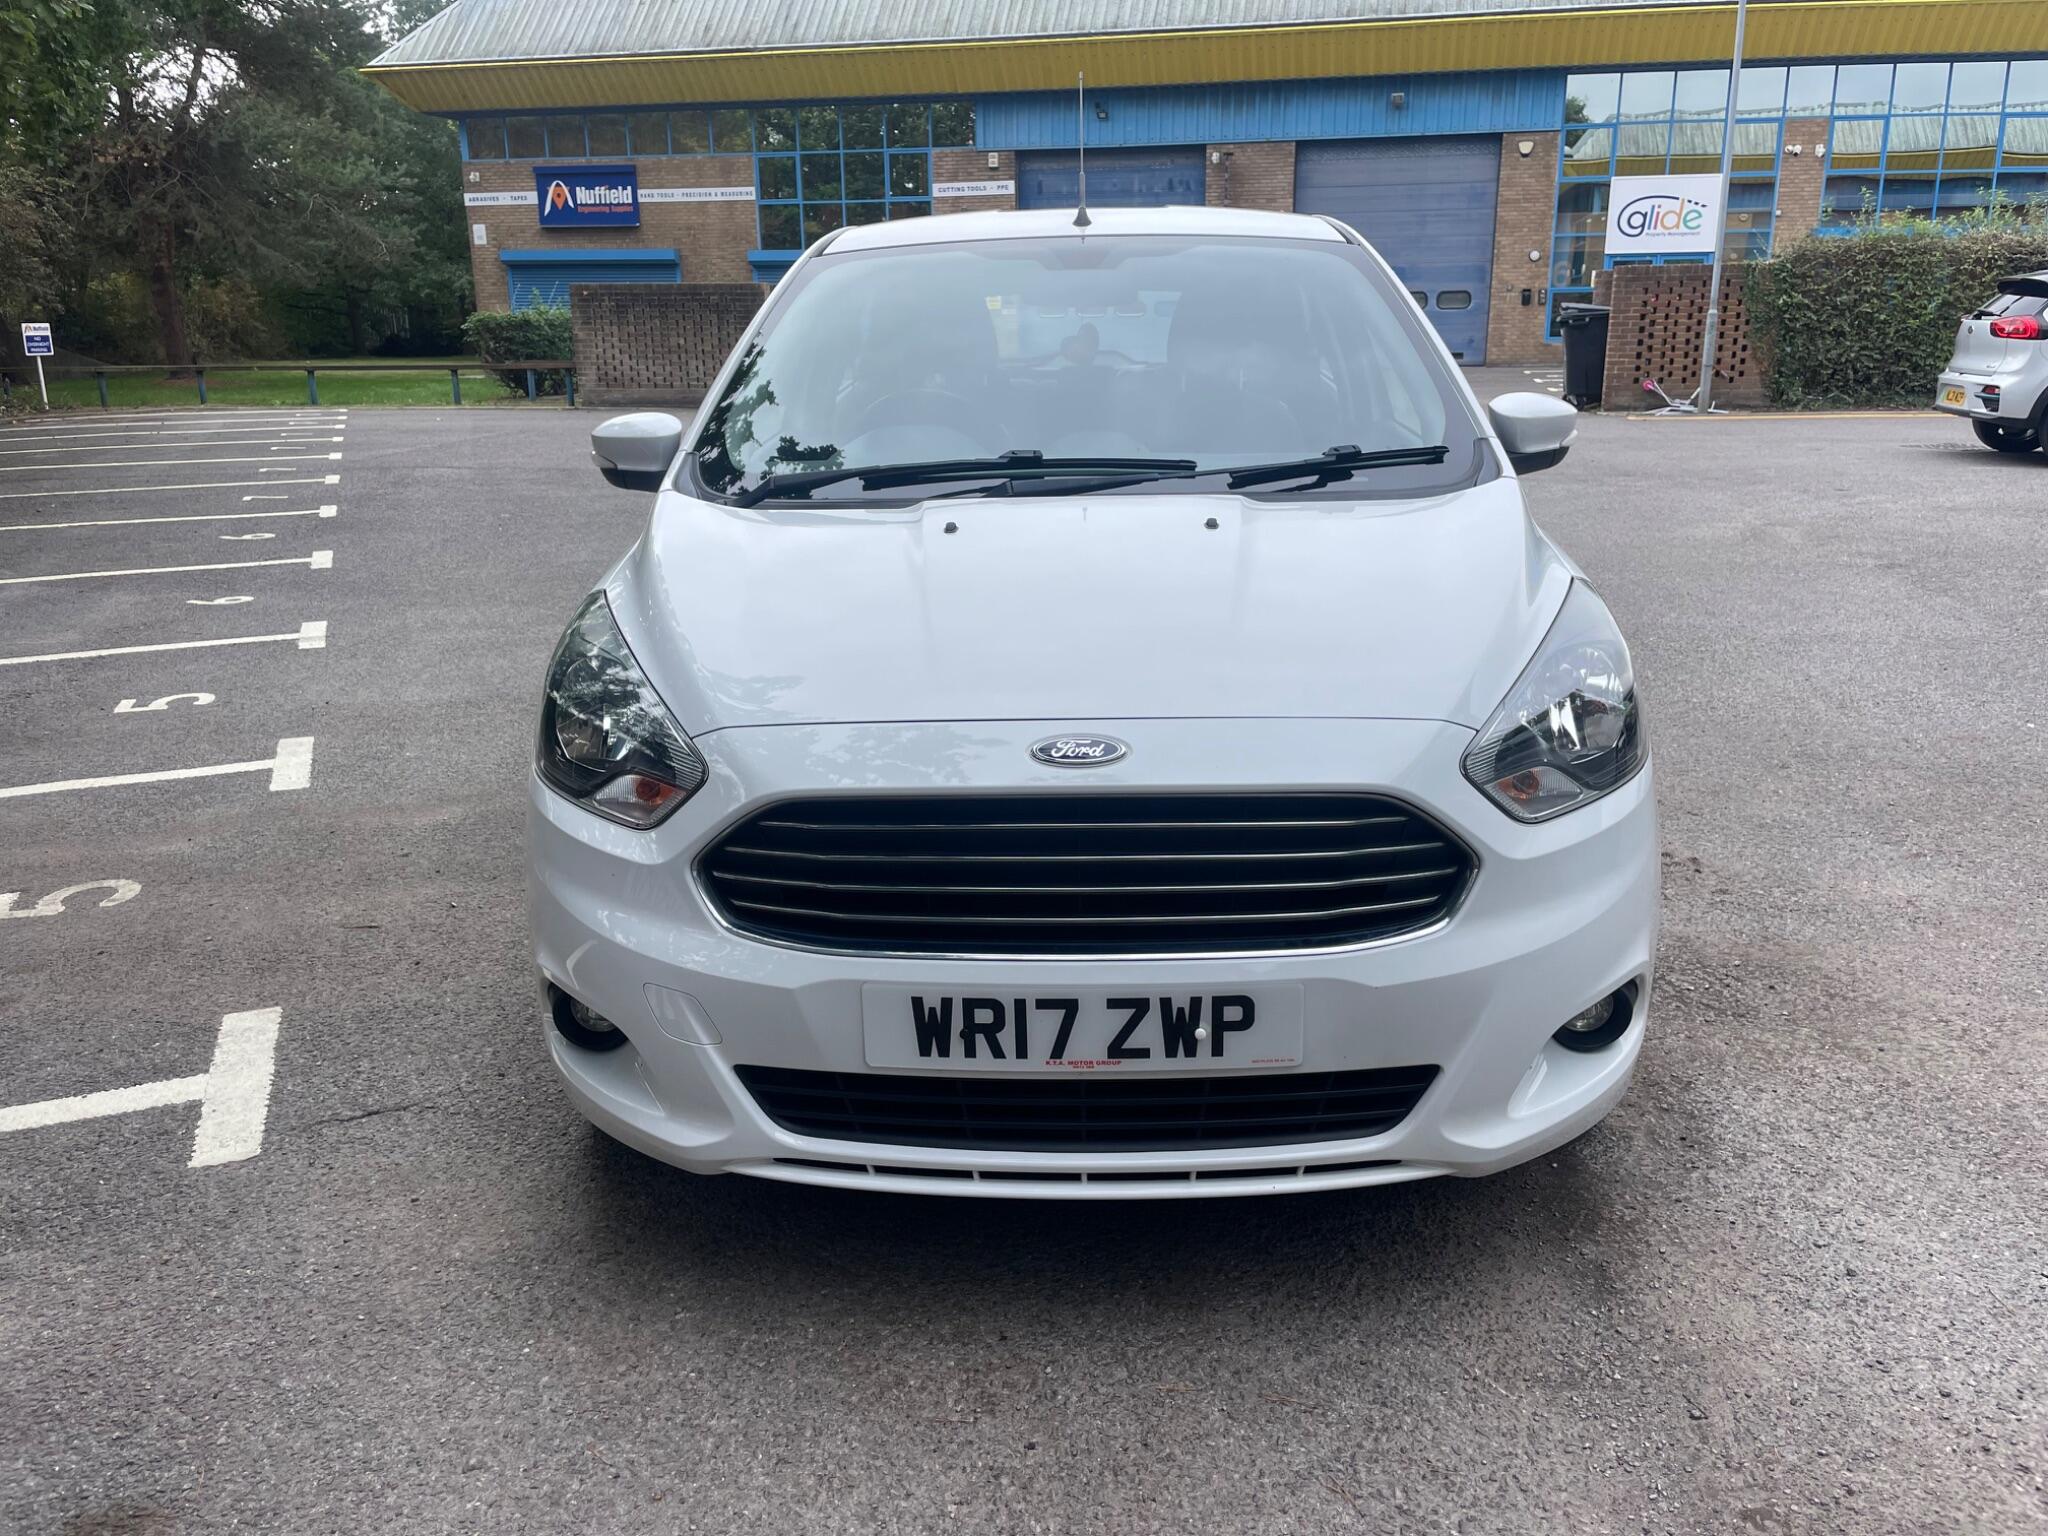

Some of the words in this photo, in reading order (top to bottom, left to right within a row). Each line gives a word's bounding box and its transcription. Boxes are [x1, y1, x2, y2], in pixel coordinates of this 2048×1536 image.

[576, 185, 632, 204] Nuffield
[1617, 195, 1703, 237] glide
[114, 692, 215, 713] 5
[1051, 739, 1106, 757] Ford
[911, 996, 1079, 1059] WR17
[1106, 994, 1255, 1059] ZWP
